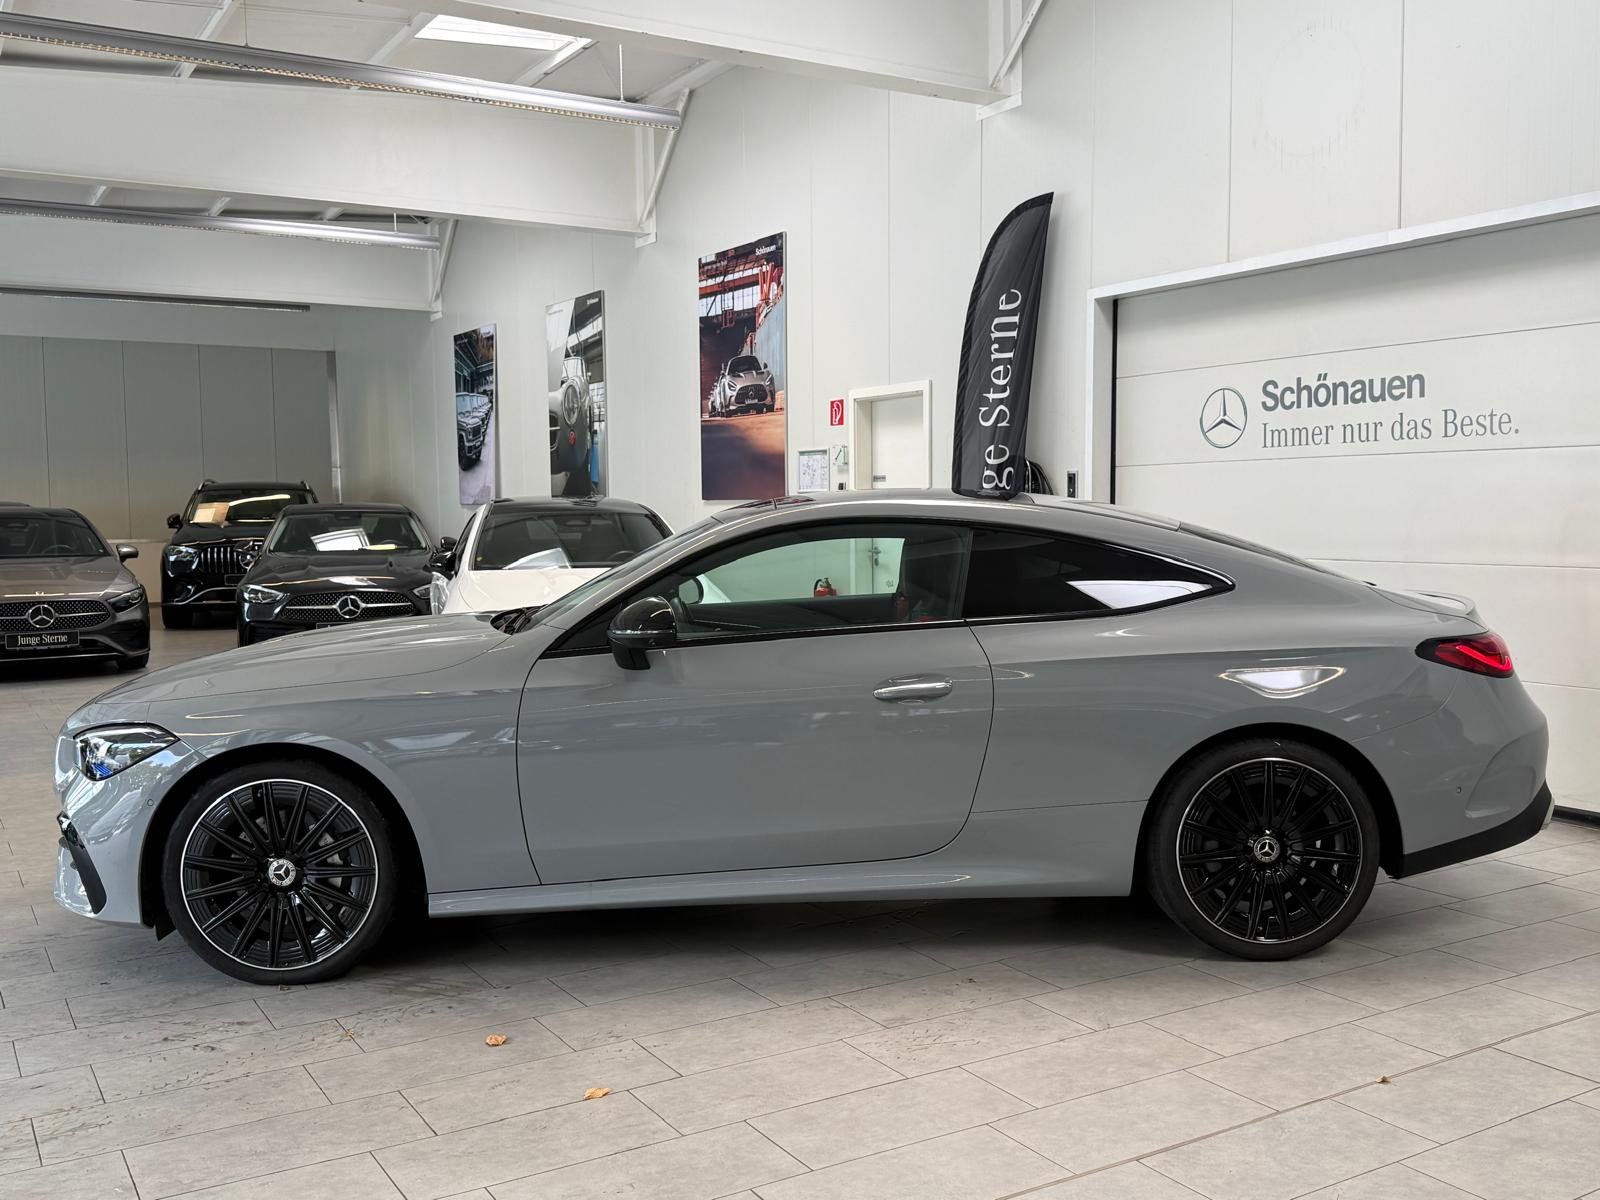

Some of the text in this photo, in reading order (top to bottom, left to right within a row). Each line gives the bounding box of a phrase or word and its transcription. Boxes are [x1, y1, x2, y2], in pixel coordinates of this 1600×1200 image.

[979, 288, 1022, 427] Sterne
[1261, 372, 1426, 412] Schönauen
[1262, 407, 1520, 448] Immer nur das Beste.
[17, 633, 68, 646] Junge Sterne
